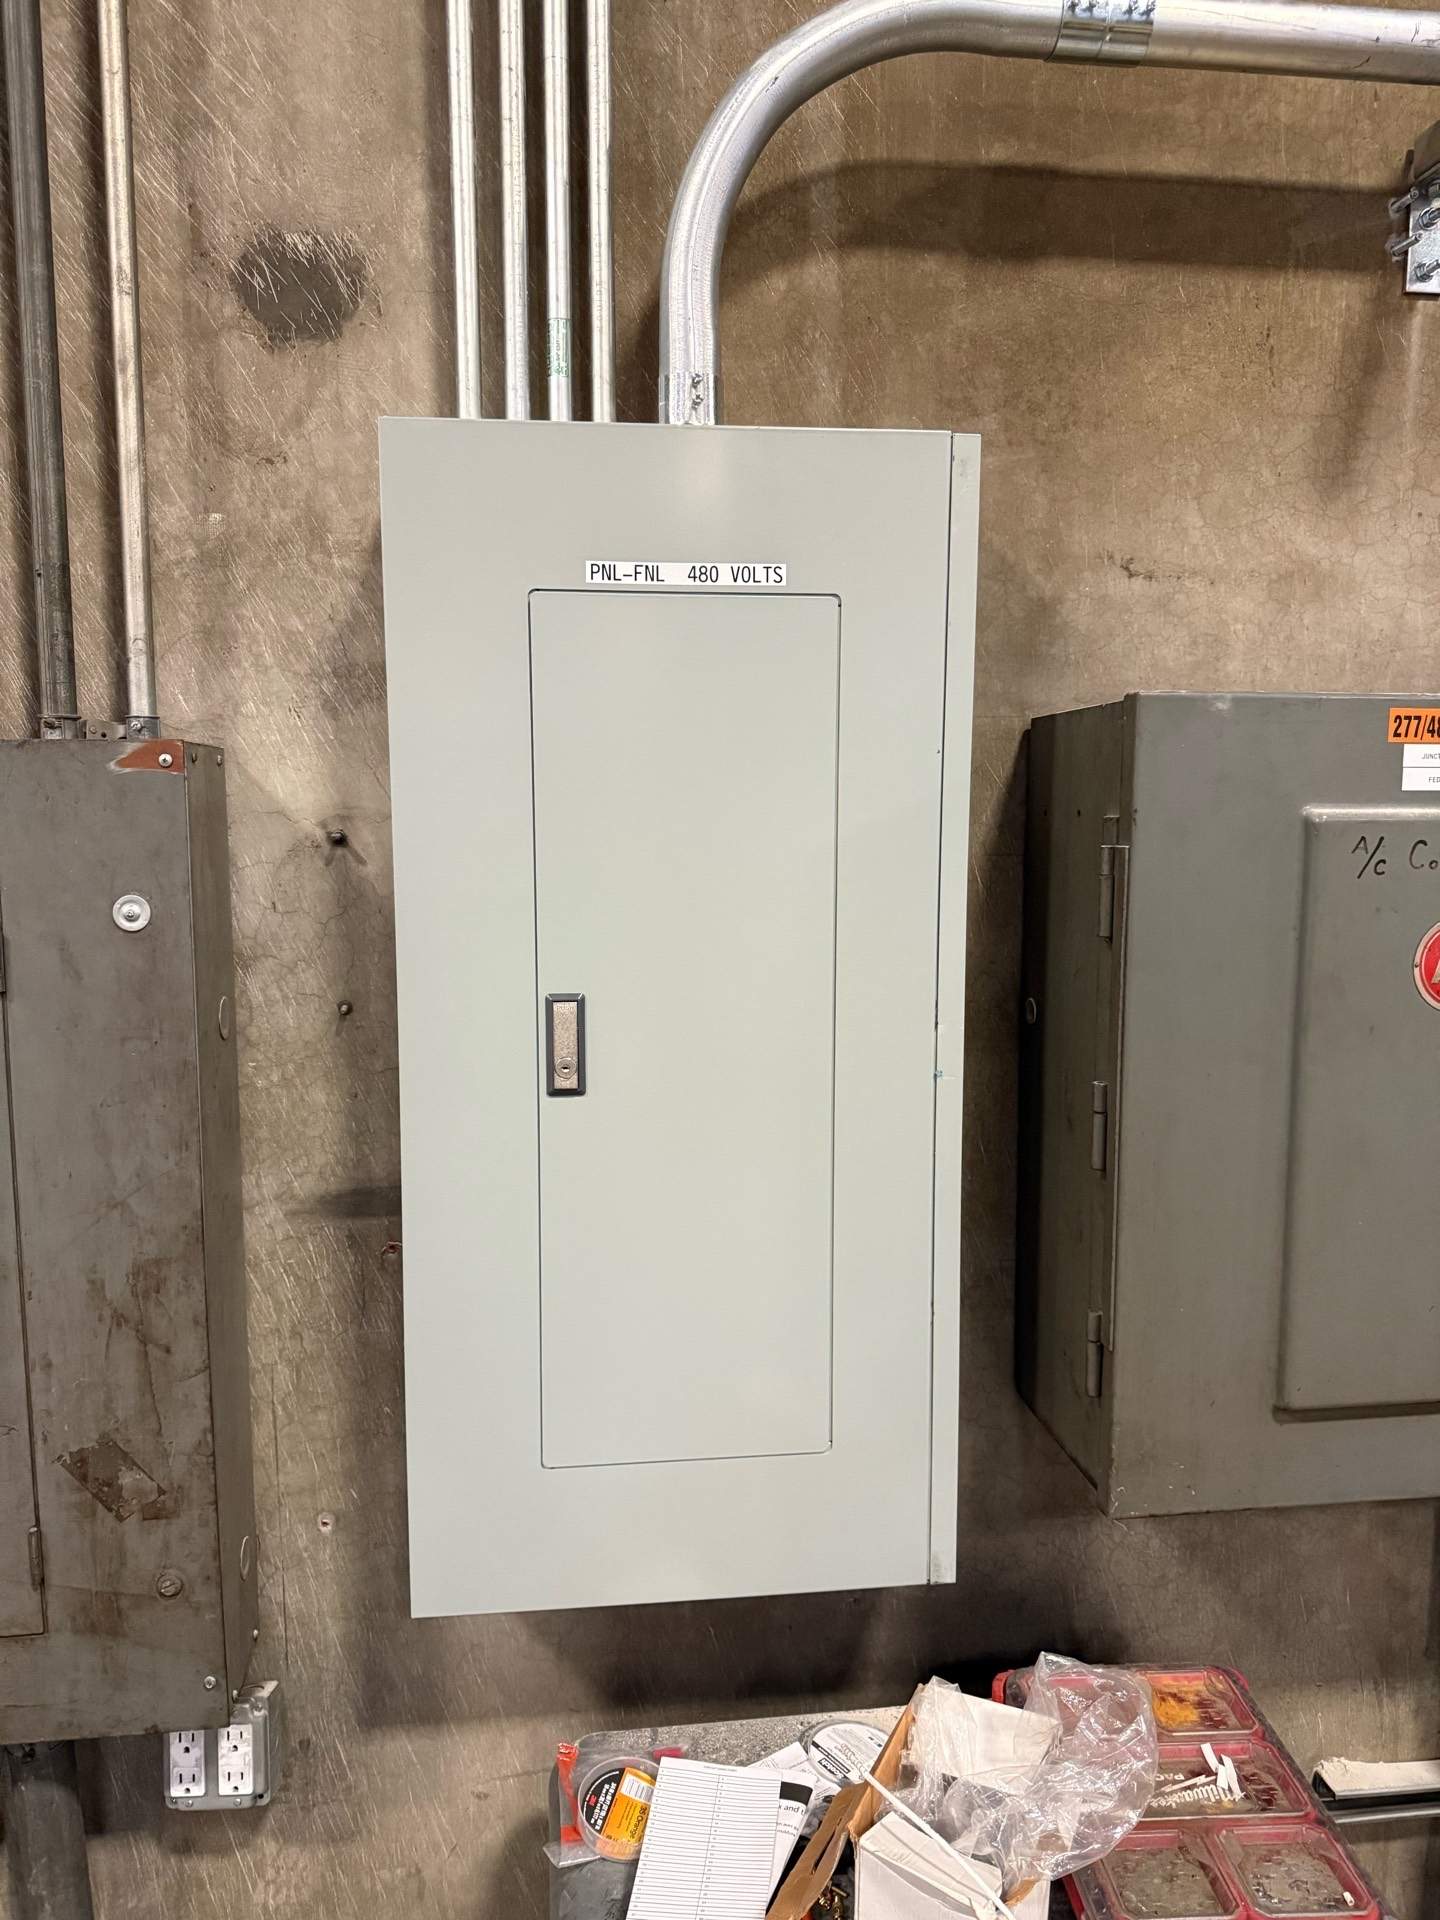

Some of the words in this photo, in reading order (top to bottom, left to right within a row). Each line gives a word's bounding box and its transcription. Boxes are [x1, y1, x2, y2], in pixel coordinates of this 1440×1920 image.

[590, 563, 665, 582] PNL-FNL
[687, 565, 719, 583] 480
[731, 565, 783, 584] VOLTS
[783, 1804, 799, 1813] and
[629, 1815, 645, 1840] Orange
